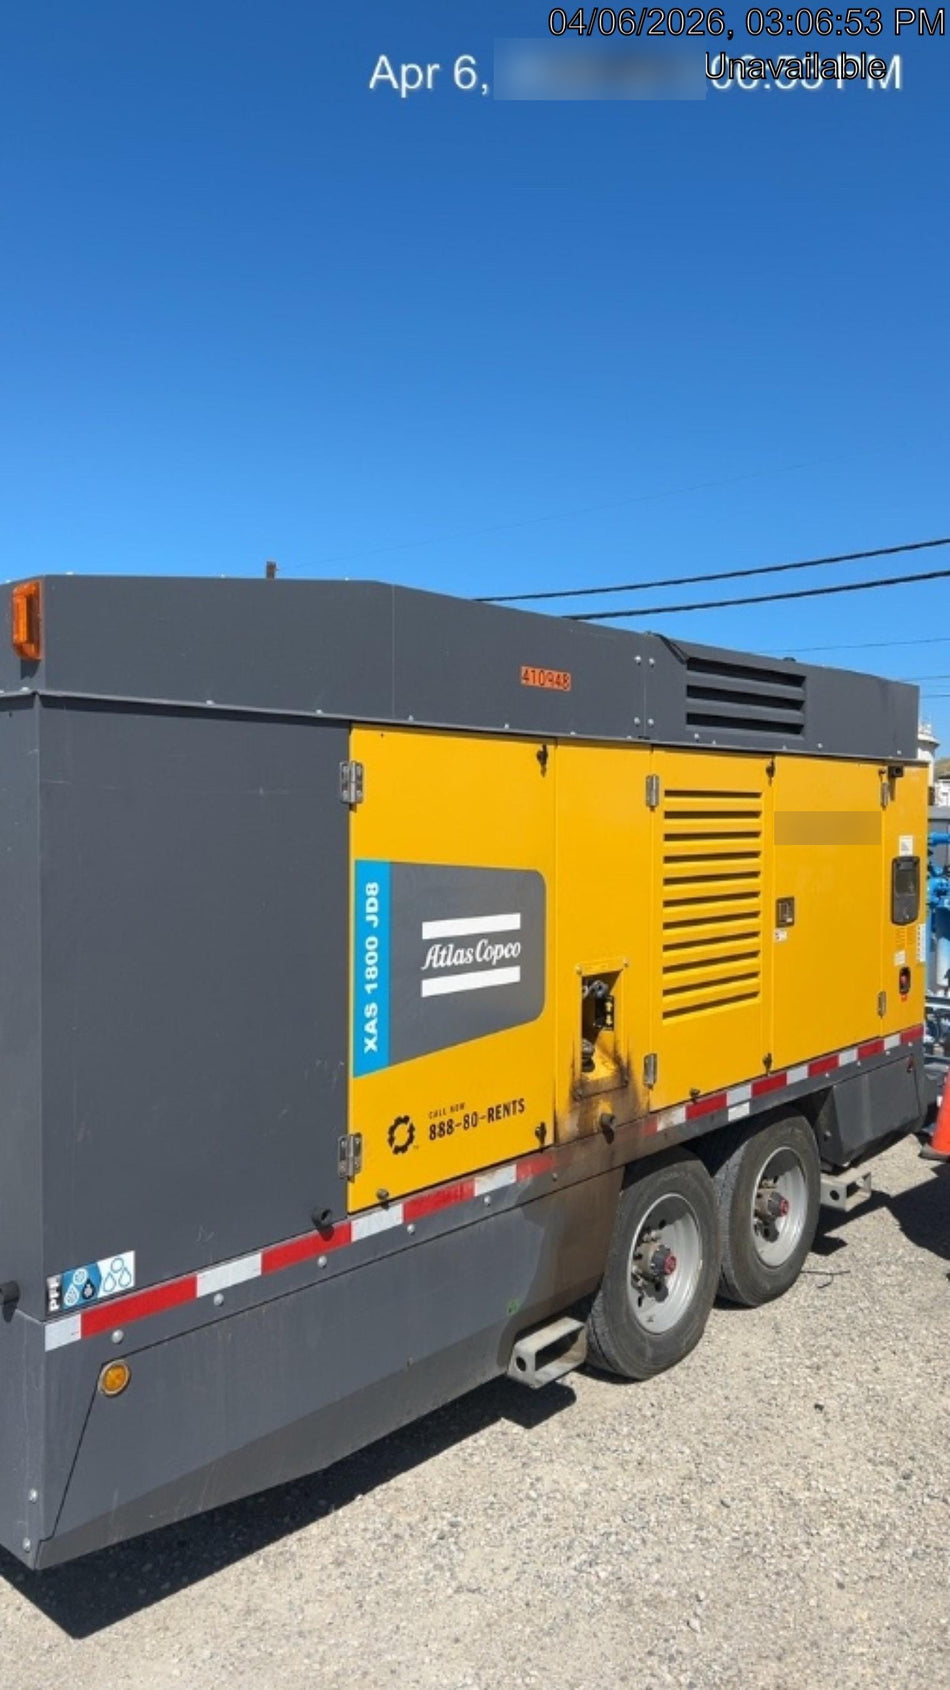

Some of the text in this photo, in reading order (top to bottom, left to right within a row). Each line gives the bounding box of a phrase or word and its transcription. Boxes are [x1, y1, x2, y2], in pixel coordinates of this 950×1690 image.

[521, 668, 570, 691] 410948
[364, 882, 380, 1053] XAS 1800 JD8
[421, 939, 521, 970] Atlas Copco
[428, 1107, 446, 1120] CALL
[429, 1097, 525, 1141] 888-80-RENTS
